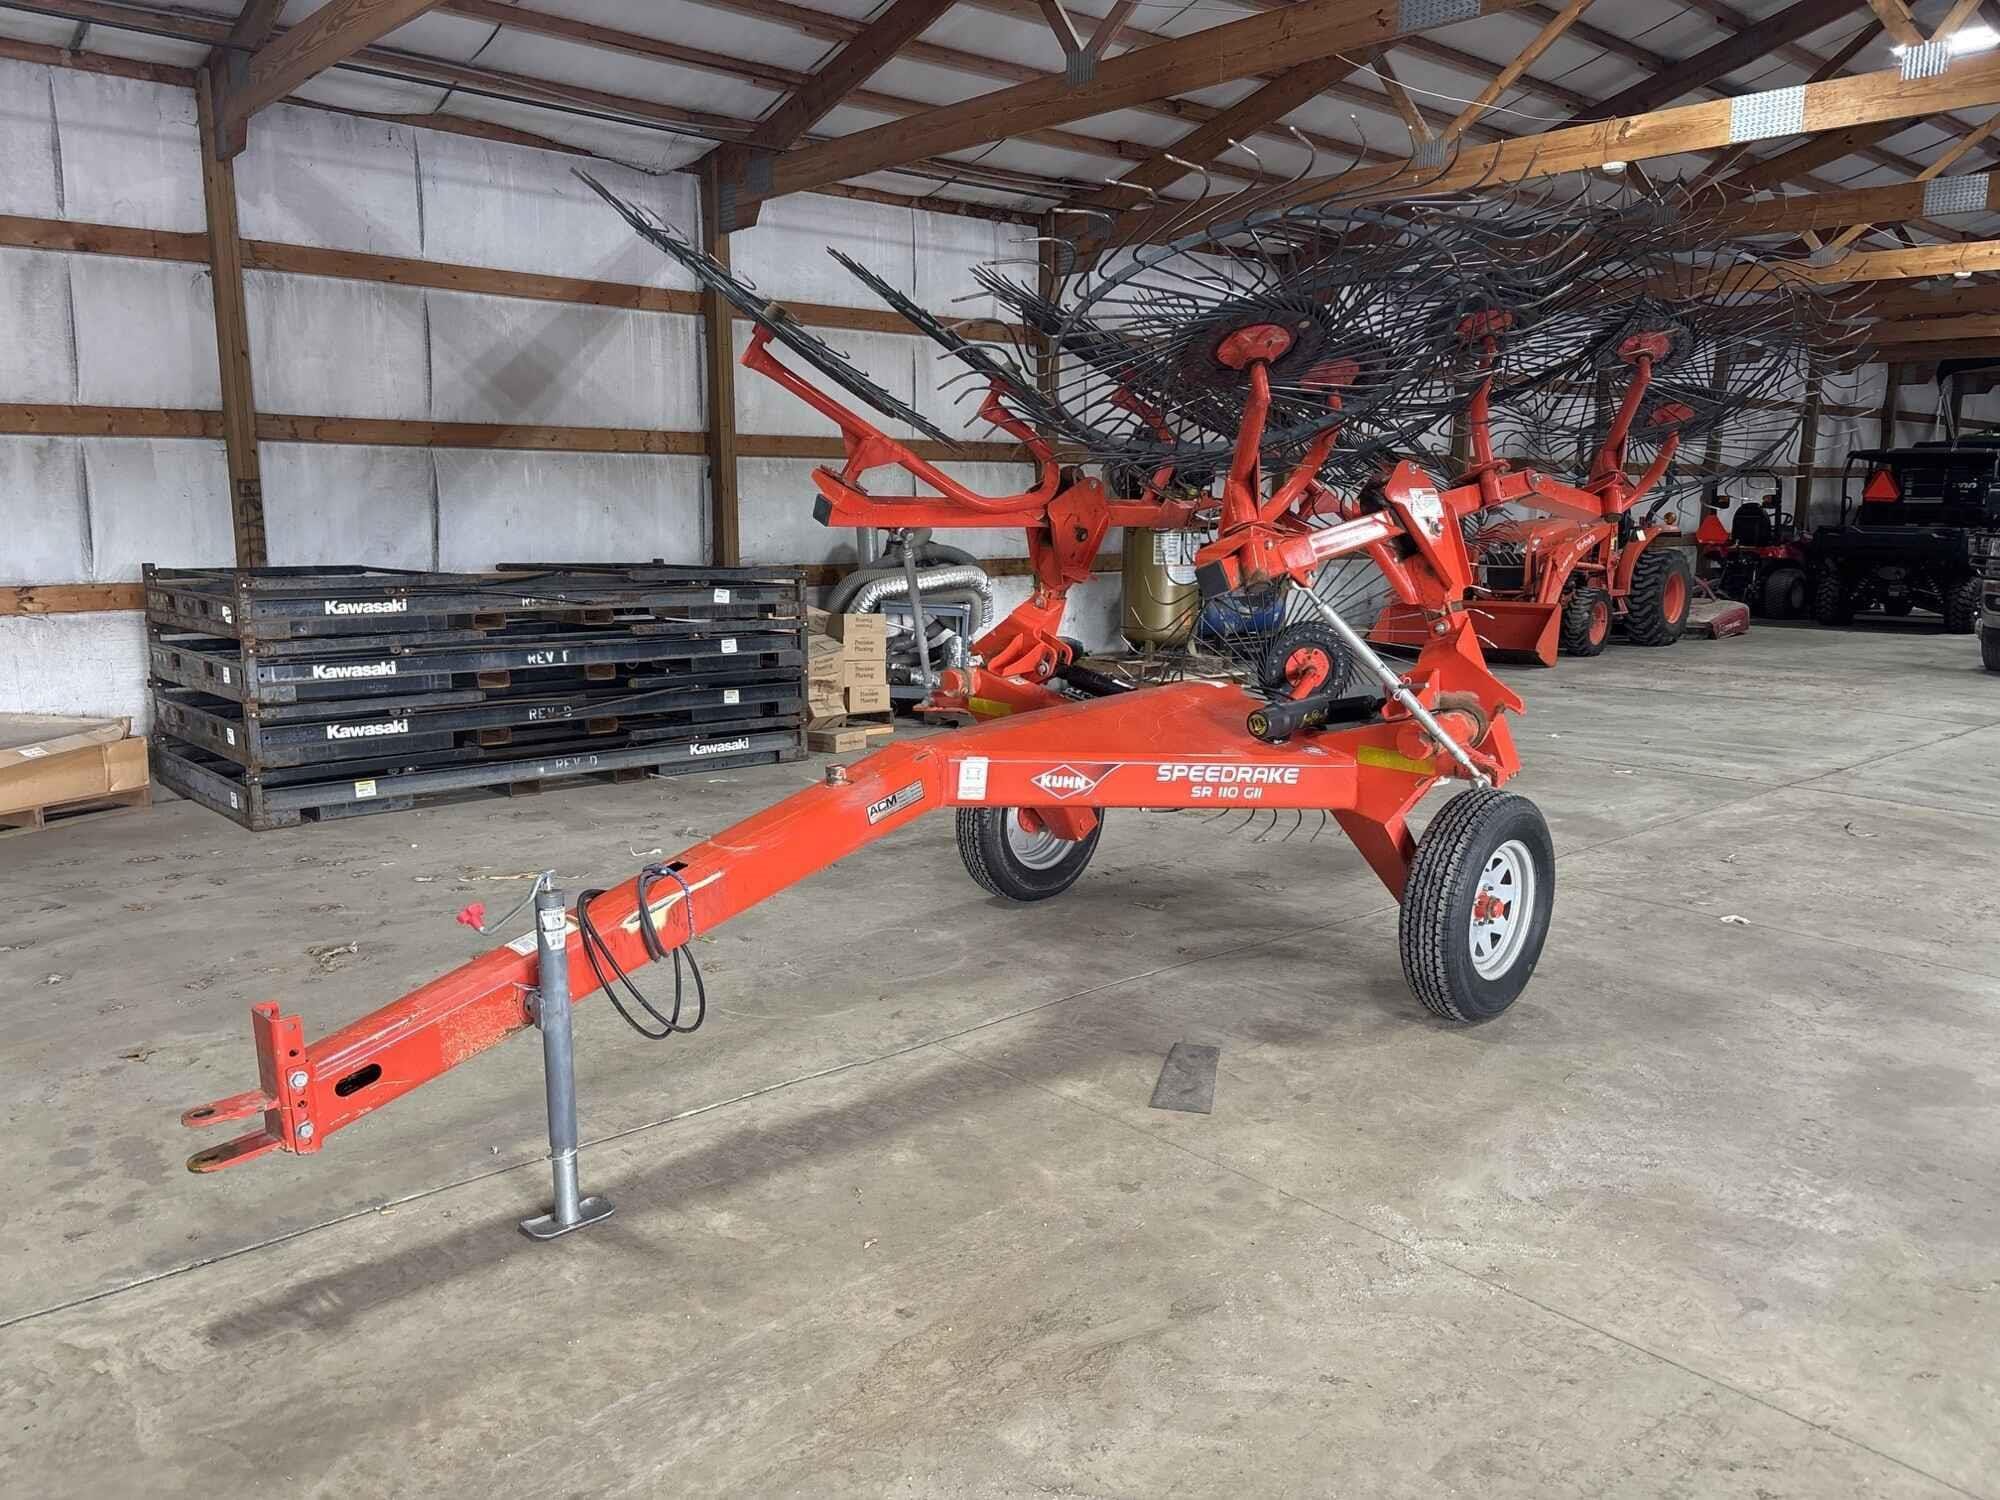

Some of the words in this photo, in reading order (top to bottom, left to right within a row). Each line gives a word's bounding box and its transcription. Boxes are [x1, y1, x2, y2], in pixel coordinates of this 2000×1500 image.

[325, 599, 408, 615] Kawasaki
[528, 651, 554, 664] REV
[312, 661, 397, 679] Kawasaki
[326, 719, 409, 739] Kawasaki
[689, 738, 749, 756] Kawasaki
[555, 757, 580, 769] REV
[1040, 775, 1087, 789] KUHN
[1156, 764, 1300, 784] SPEEDRAKE
[1191, 786, 1213, 798] SR
[1218, 786, 1239, 799] 110
[1243, 787, 1263, 799] GII
[870, 795, 897, 816] ACM
